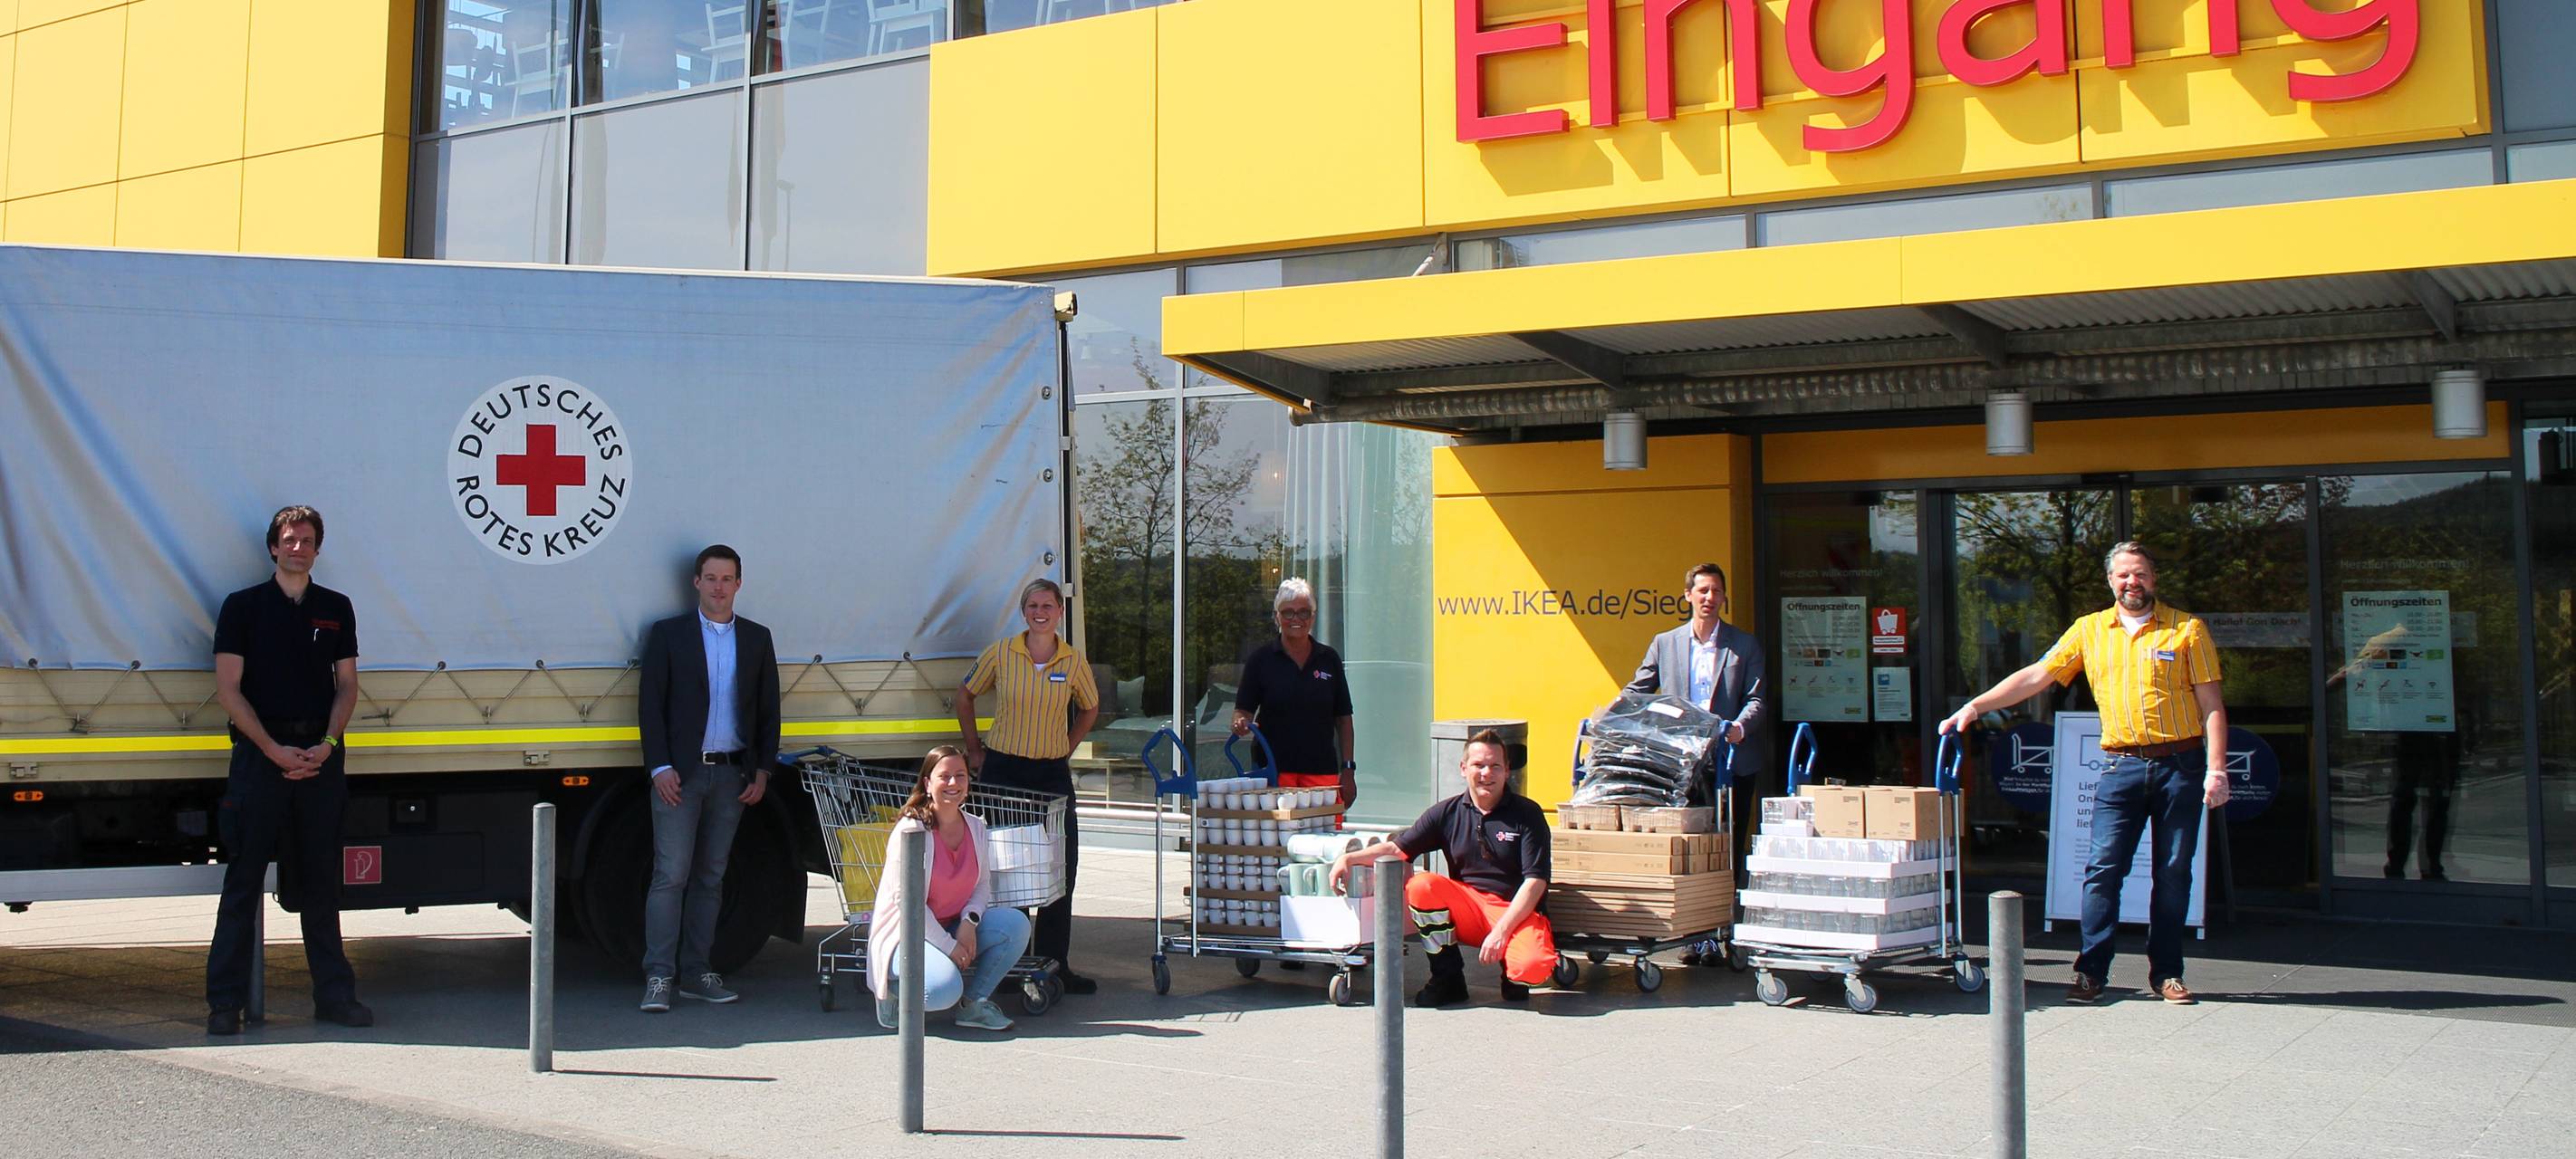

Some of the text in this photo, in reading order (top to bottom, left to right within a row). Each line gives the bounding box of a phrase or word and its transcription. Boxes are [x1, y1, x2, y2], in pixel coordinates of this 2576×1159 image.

[457, 384, 623, 460] DEUTSCHES
[457, 474, 626, 557] ROTES KREUZ
[1437, 589, 1729, 621] www.IKEA.de/Sieg
[1786, 601, 1860, 612] Öffnungszeiten
[2350, 595, 2442, 608] Öffnungszeiten
